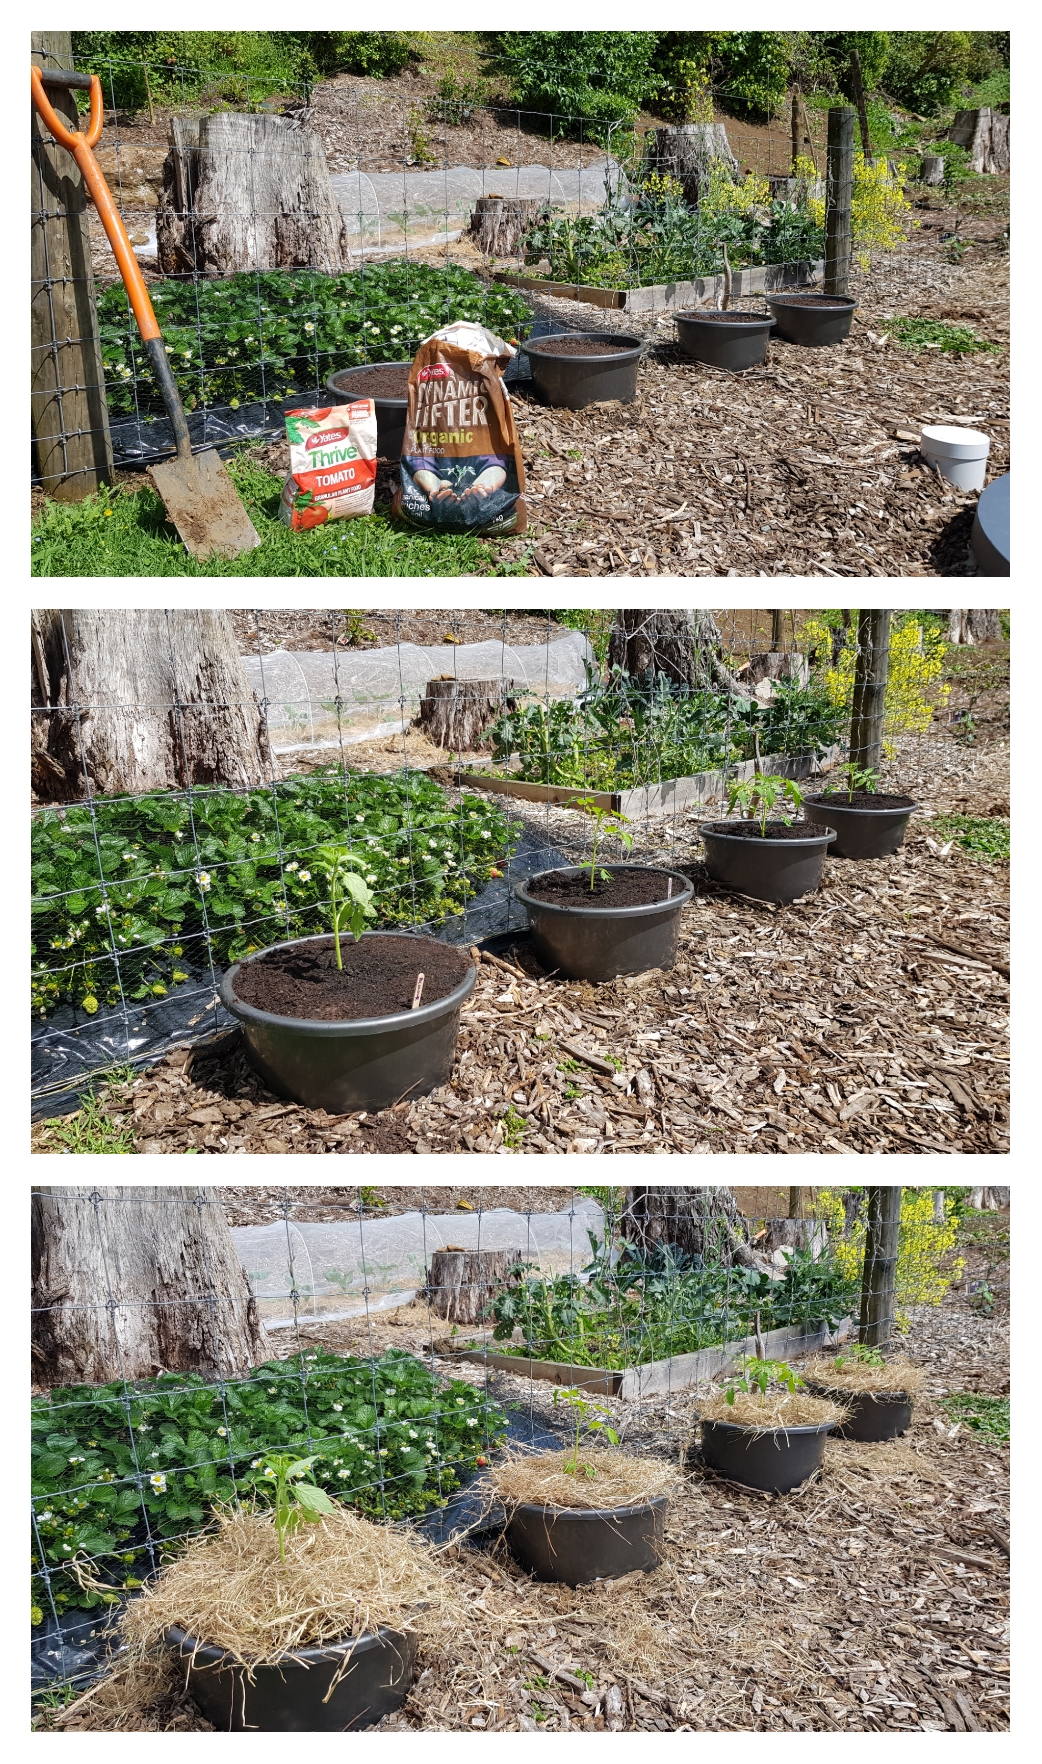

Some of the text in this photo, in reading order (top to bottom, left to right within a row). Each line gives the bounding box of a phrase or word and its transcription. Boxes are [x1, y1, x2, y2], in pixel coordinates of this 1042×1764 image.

[417, 380, 489, 408] DYNAMIC
[415, 395, 489, 428] LIFTER
[320, 431, 342, 443] Yates
[413, 428, 474, 447] Organic
[308, 445, 358, 468] Thrive
[429, 447, 445, 455] FOOD
[315, 467, 356, 488] TOMATO
[314, 490, 338, 502] GRANULAR
[338, 487, 351, 497] PLANT
